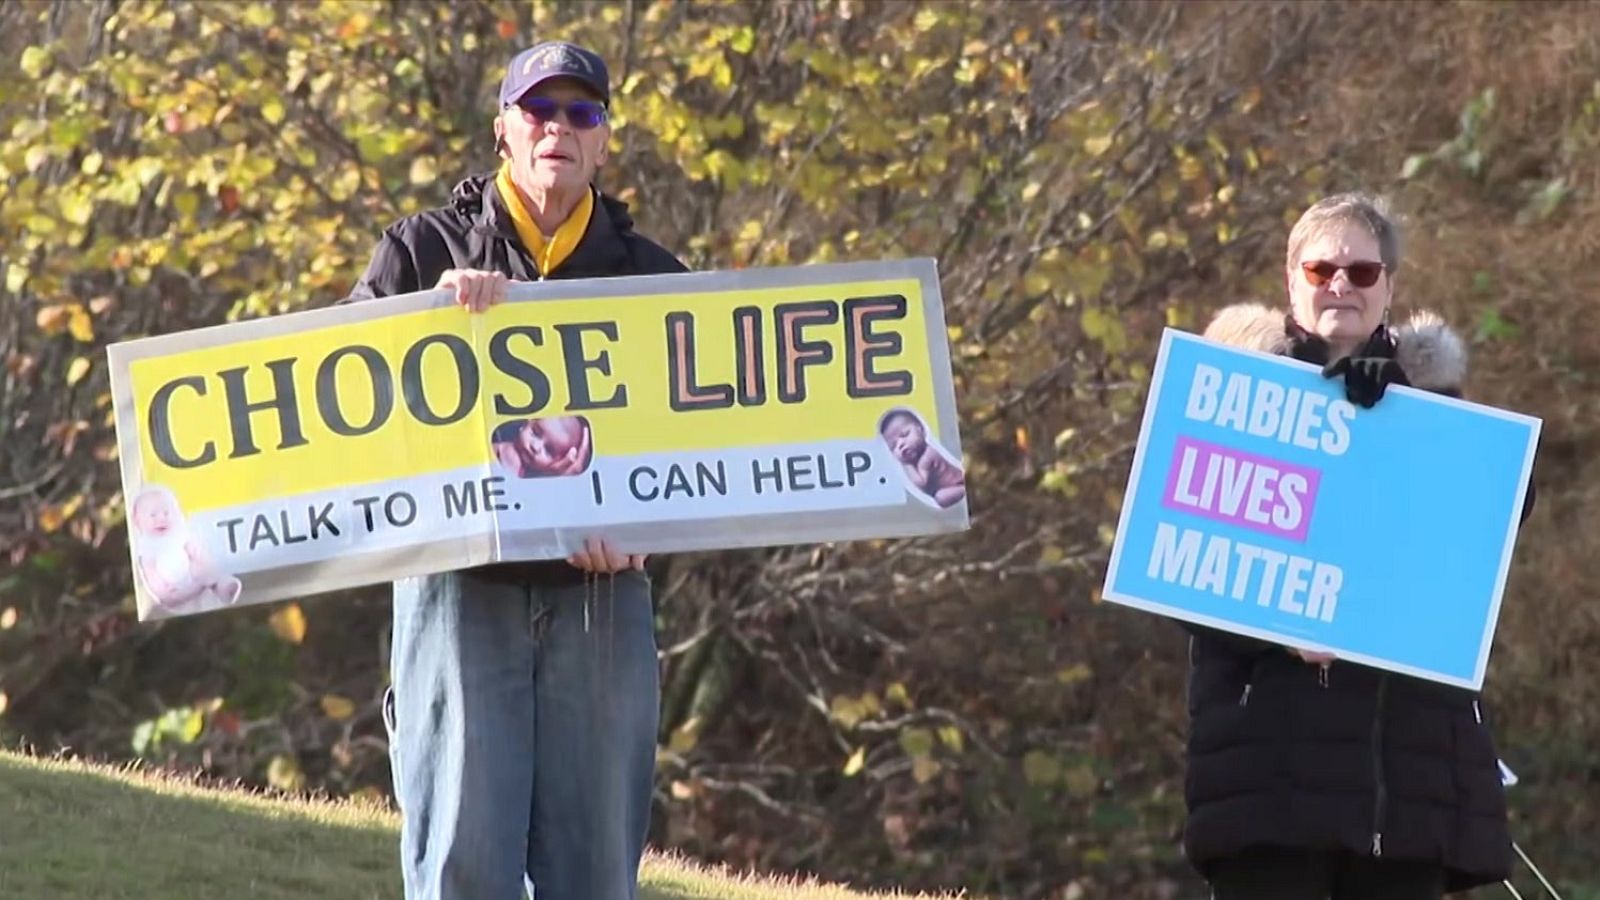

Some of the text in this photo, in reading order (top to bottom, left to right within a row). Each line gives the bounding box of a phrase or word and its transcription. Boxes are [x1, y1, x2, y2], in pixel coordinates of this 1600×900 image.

[148, 294, 914, 469] CHOOSE LIFE
[1184, 362, 1356, 456] BABIES
[217, 451, 887, 554] TALK TO ME. I CAN HELP.
[1173, 446, 1308, 531] LIVES
[1147, 522, 1344, 623] MATTER
